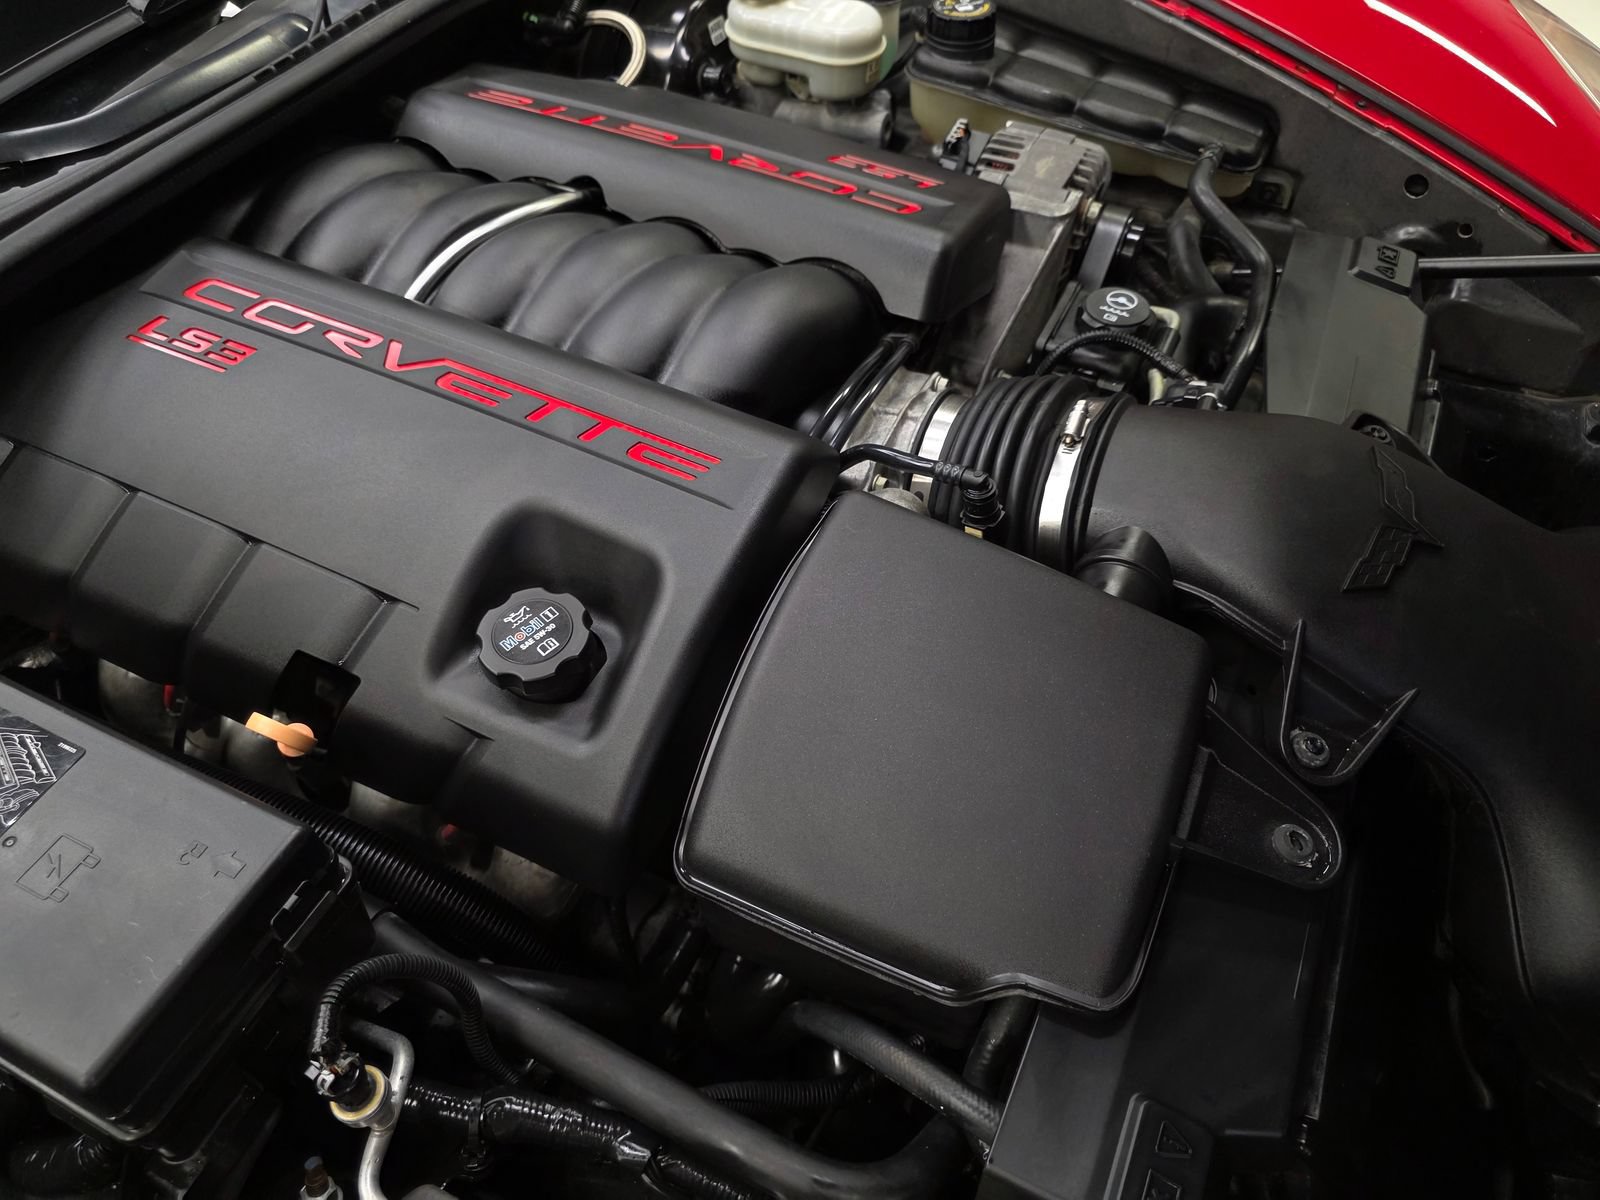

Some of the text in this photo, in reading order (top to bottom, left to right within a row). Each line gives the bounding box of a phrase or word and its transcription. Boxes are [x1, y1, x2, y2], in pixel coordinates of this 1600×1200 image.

[467, 90, 923, 214] CORVETTE
[826, 154, 941, 189] LS3
[135, 315, 257, 367] LS3
[183, 277, 722, 482] CORVETTE
[500, 617, 545, 651] Mobil
[520, 623, 556, 650] SAE 5W-30
